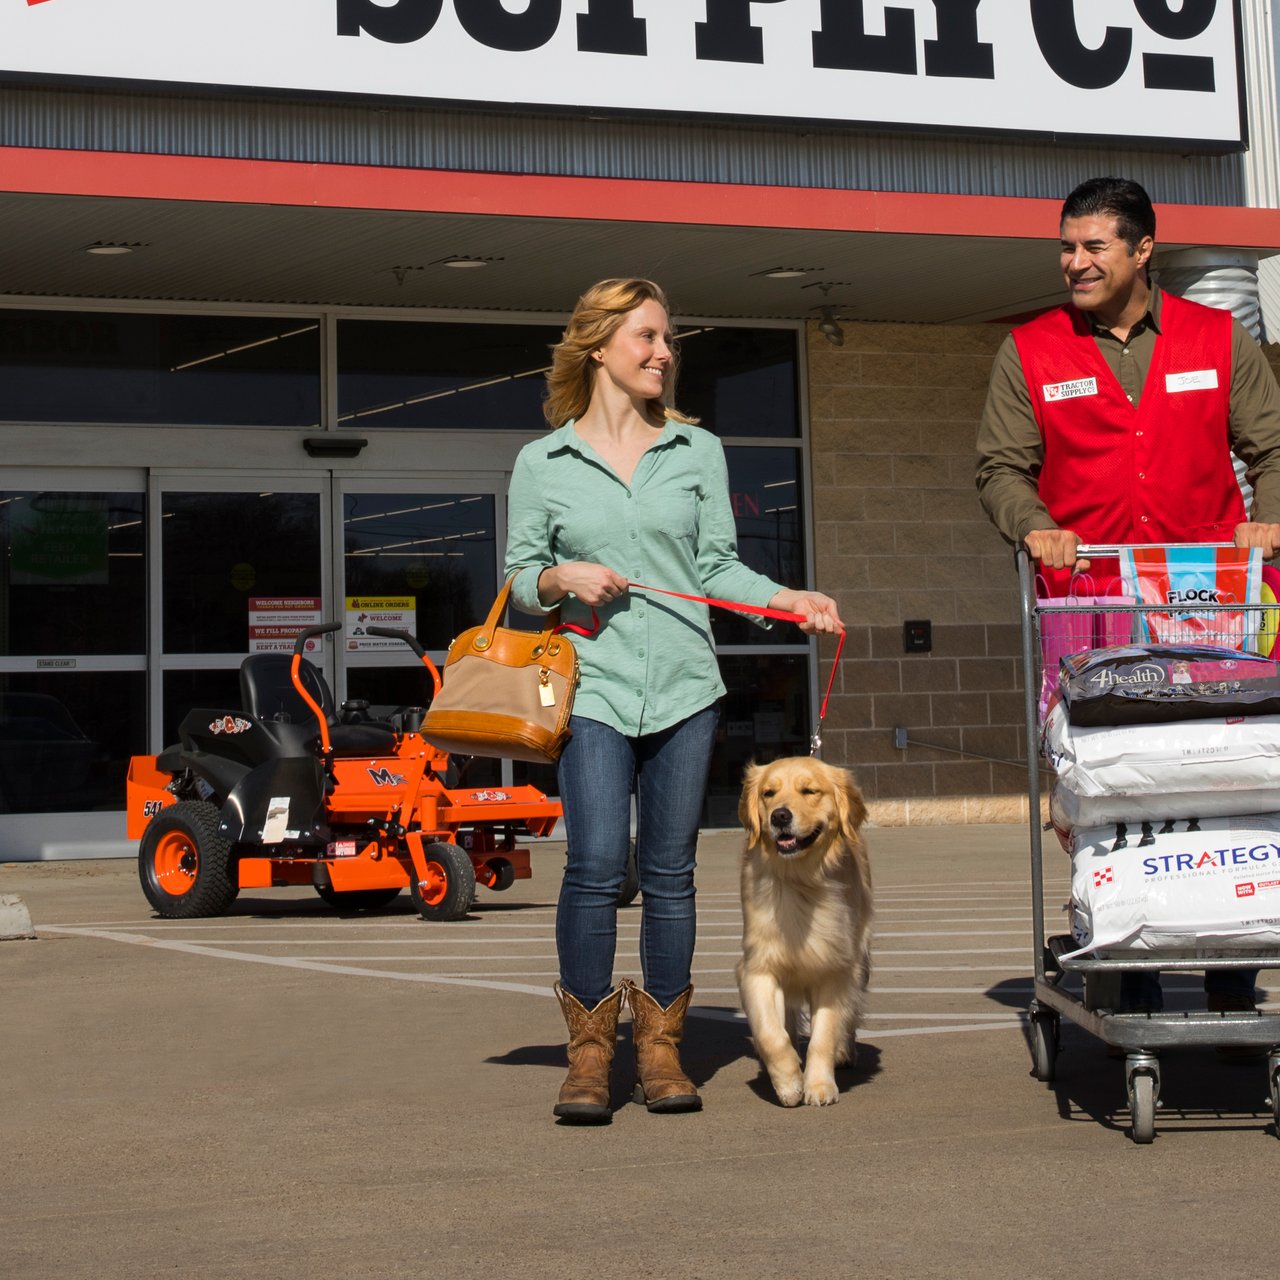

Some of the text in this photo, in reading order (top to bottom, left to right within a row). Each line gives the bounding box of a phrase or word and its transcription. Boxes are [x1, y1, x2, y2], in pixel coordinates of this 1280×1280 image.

[1060, 379, 1094, 391] TRACTOR
[1177, 375, 1200, 385] JOE
[1061, 387, 1087, 397] SUPPLY
[732, 492, 760, 518] EN
[1168, 589, 1218, 603] FLOCK
[1090, 668, 1160, 688] 4health
[1145, 870, 1217, 883] PROFESSIONAL
[1221, 864, 1267, 874] FORMULA
